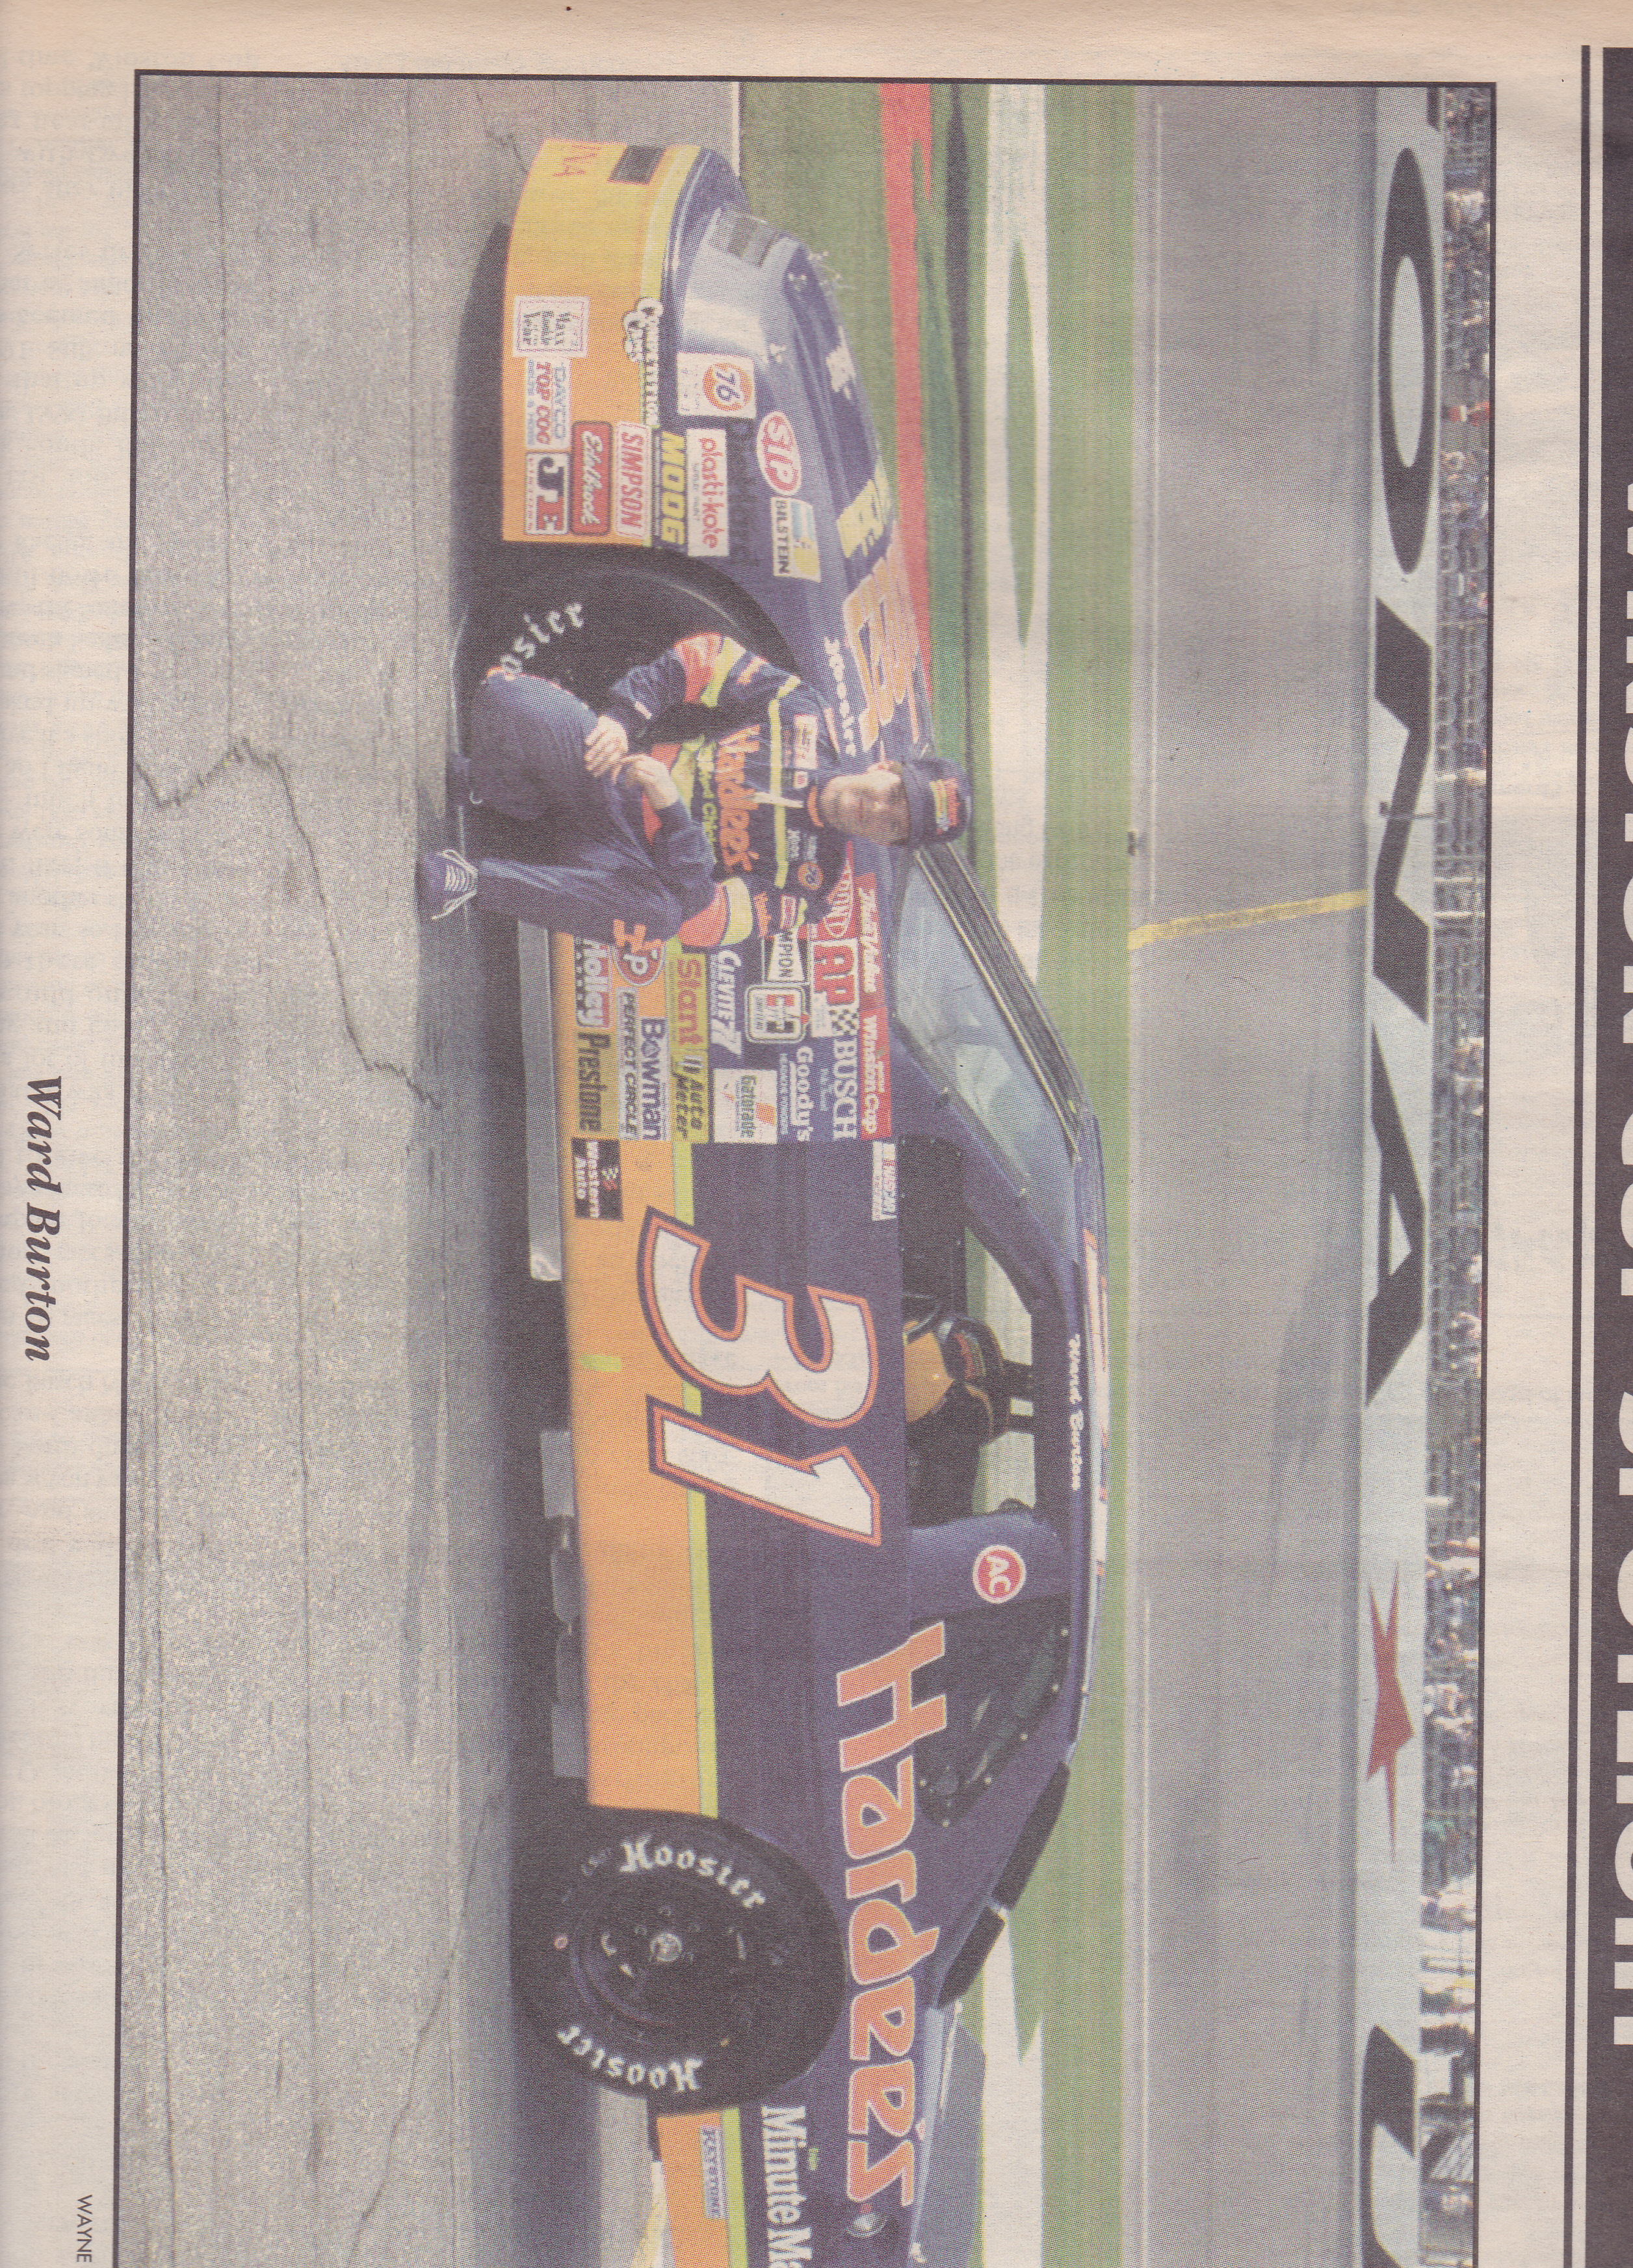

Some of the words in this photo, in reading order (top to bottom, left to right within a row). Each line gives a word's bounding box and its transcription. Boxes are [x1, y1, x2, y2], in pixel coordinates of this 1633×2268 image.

[522, 311, 541, 347] Year
[637, 297, 664, 427] COMPETITION
[536, 362, 552, 401] TOP
[554, 366, 567, 440] DAYCO
[715, 371, 740, 402] 76
[536, 405, 553, 445] COG
[761, 415, 799, 492] STP
[536, 456, 565, 533] JE
[577, 430, 603, 525] Edelbrock
[620, 431, 644, 529] SIMPSON
[661, 430, 685, 545] MOOG
[698, 438, 725, 549] plasti-kote
[776, 500, 790, 575] BILSTEIN
[824, 637, 857, 758] Hoosier
[715, 724, 760, 872] Hardee's
[1366, 147, 1438, 1408] ONA
[718, 950, 742, 1020] CLEVITE
[776, 932, 795, 978] MPION
[813, 944, 856, 1007] AP
[623, 992, 636, 1069] PERFECT
[677, 958, 704, 1046] Stant
[577, 1032, 612, 1132] Prestone
[640, 1018, 666, 1141] Bowman
[833, 1038, 857, 1141] BUSCH
[863, 1015, 879, 1092] Winston
[625, 1073, 638, 1135] CIRCLE
[672, 1073, 688, 1140] Meter
[690, 1079, 705, 1131] Auto
[740, 1075, 757, 1139] Gatorade
[789, 1046, 815, 1142] Goody's
[862, 1094, 879, 1133] Cup
[27, 1075, 62, 1193] Ward
[575, 1156, 587, 1199] Auto
[586, 1141, 601, 1218] Western
[883, 1164, 897, 1213] NASCAR
[25, 1202, 60, 1362] Burton
[636, 1205, 882, 1547] 31
[1069, 1334, 1082, 1404] Ward
[1069, 1409, 1085, 1491] Burton
[986, 1553, 1012, 1595] AC
[619, 1834, 766, 1908] Hoosier
[556, 2025, 703, 2094] Hoosier
[702, 2129, 720, 2219] KEYSTONE
[761, 2105, 808, 2224] Minute
[76, 2195, 93, 2263] WAYNE
